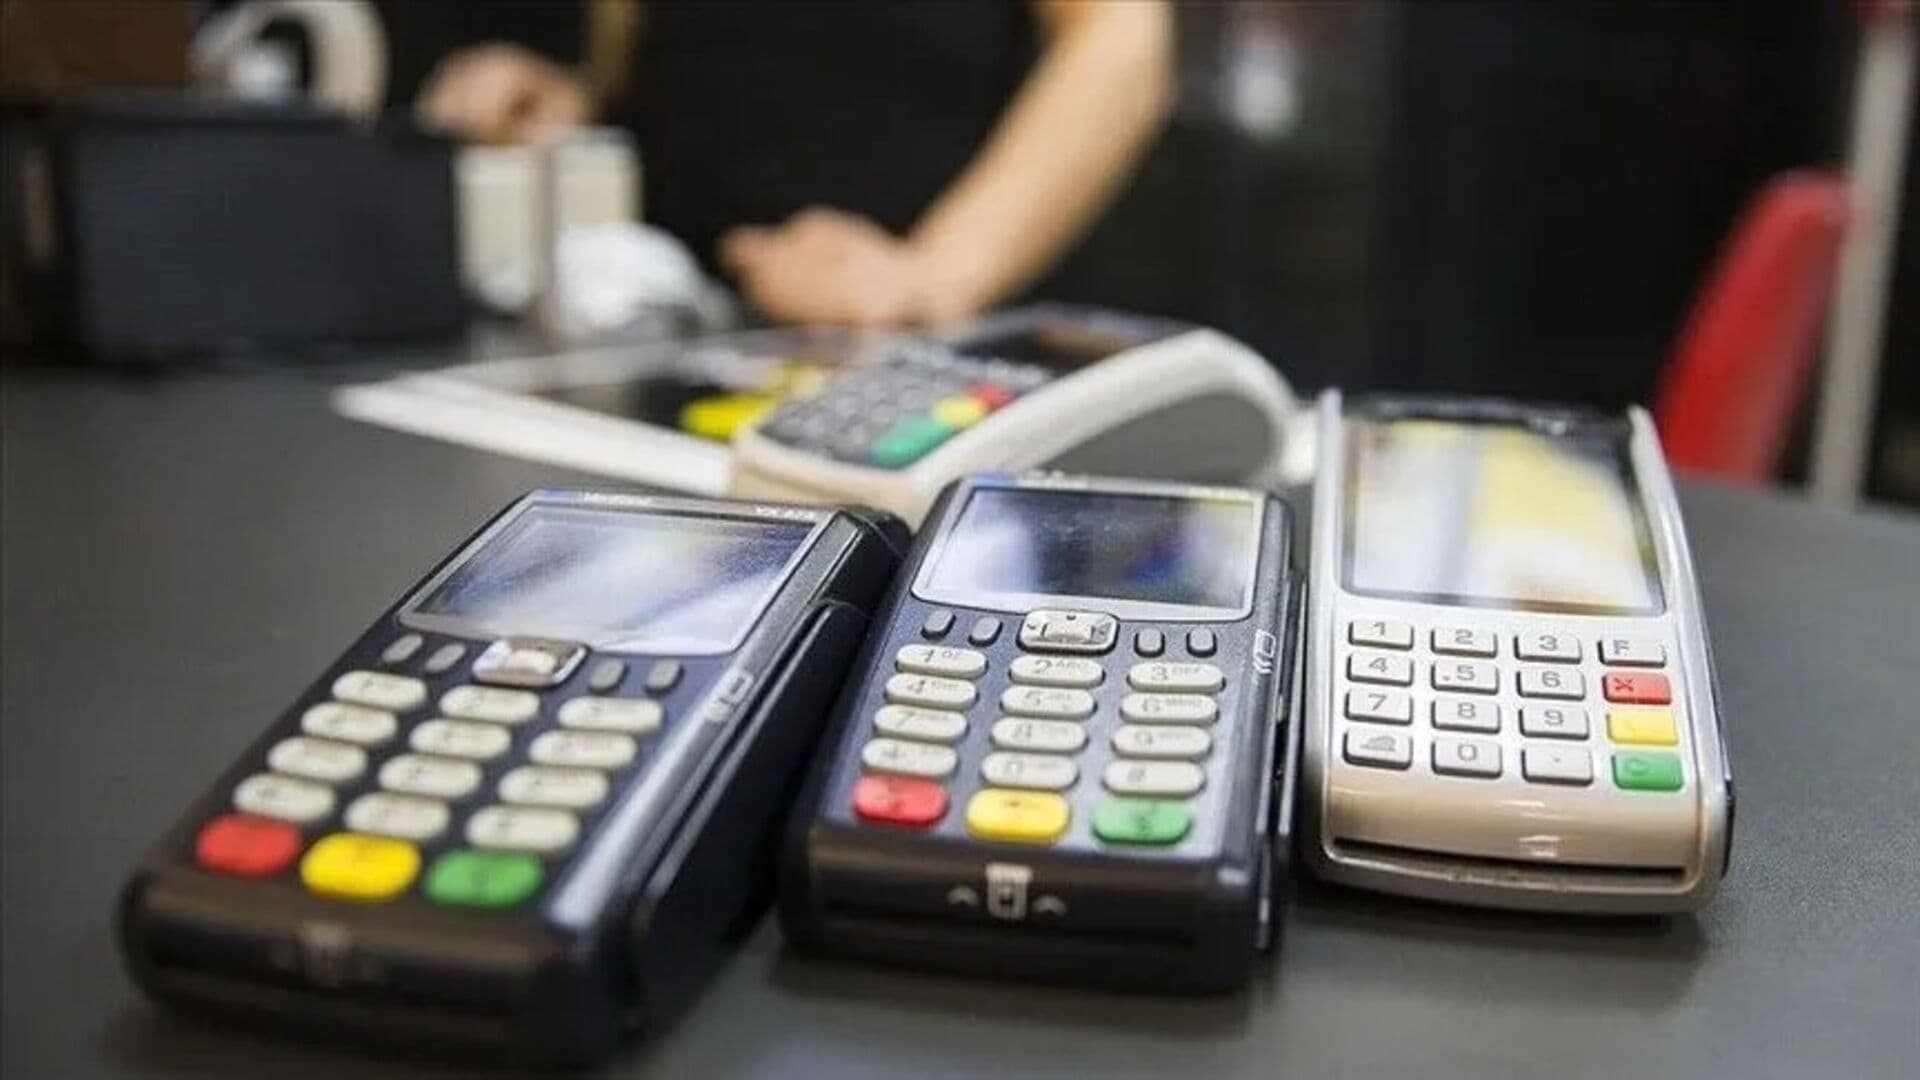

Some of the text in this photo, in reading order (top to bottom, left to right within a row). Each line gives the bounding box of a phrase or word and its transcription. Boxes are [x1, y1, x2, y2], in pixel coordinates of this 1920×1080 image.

[1373, 622, 1386, 636] 1
[1455, 629, 1474, 645] 2
[1538, 635, 1559, 651] 3
[1613, 639, 1630, 655] F
[1034, 658, 1052, 674] 2
[1150, 664, 1168, 681] 3
[1368, 657, 1389, 673] 4
[1456, 665, 1476, 681] 5
[1541, 671, 1562, 688] 6
[1143, 696, 1161, 713] 6
[1367, 693, 1387, 711] 7
[1457, 702, 1477, 718] 8
[1544, 709, 1565, 727] 9
[1457, 743, 1478, 762] 0
